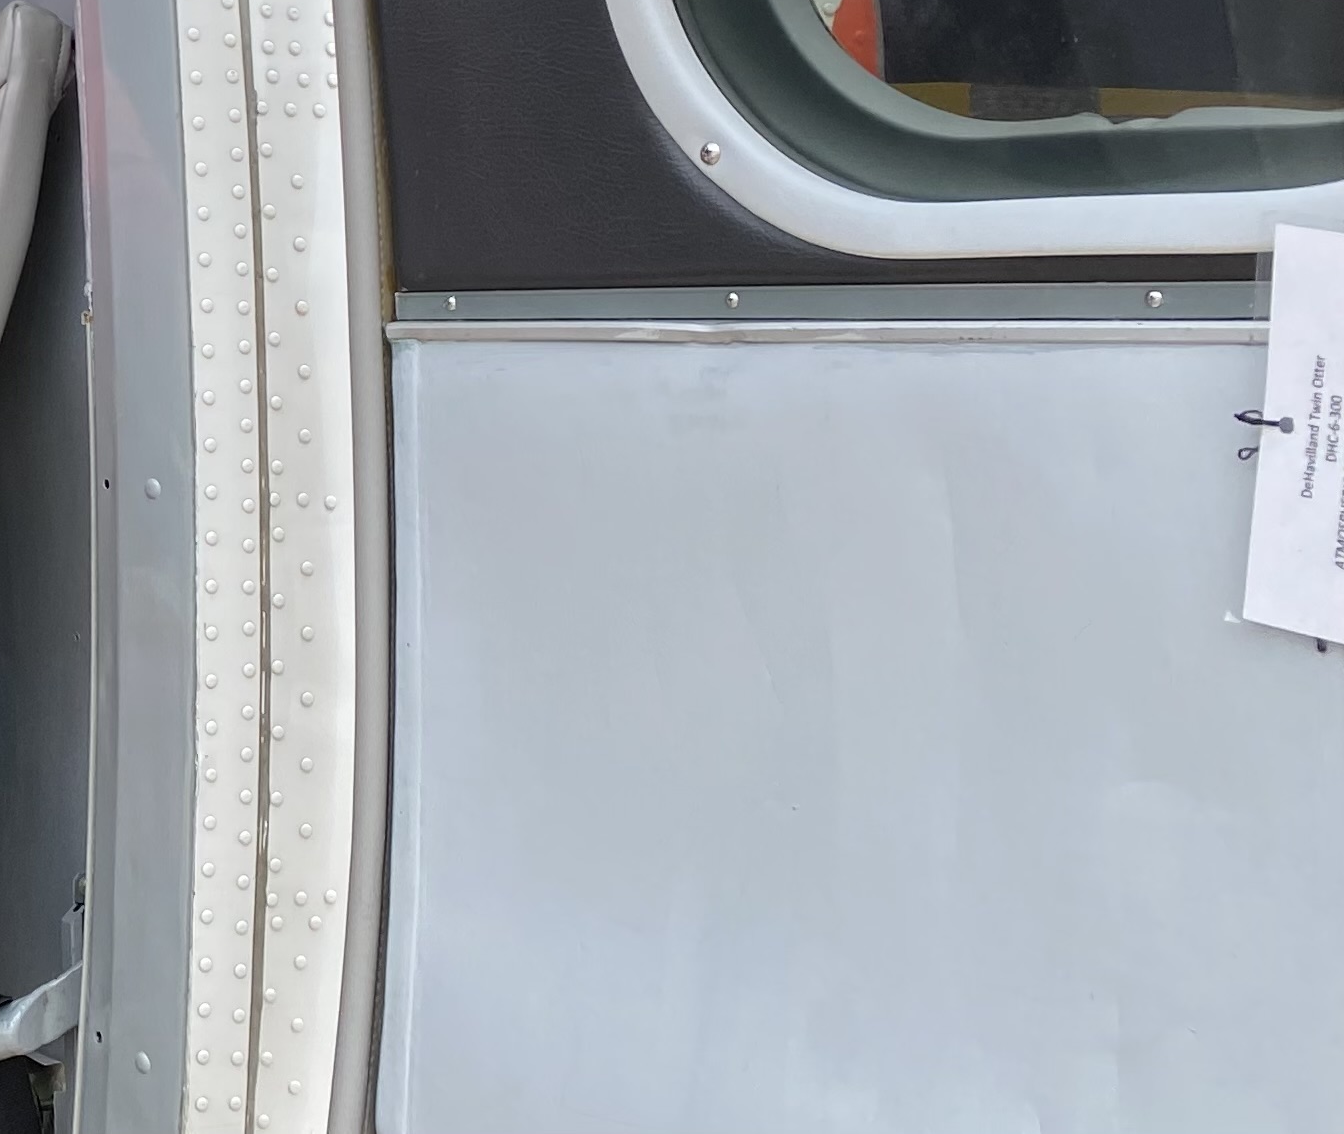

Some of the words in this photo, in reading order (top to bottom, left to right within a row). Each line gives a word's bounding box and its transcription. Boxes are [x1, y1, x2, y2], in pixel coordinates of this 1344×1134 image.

[1312, 354, 1327, 388] Otter
[1309, 392, 1323, 421] Twin
[1325, 395, 1343, 463] DHC-6-300
[1301, 424, 1320, 499] DeHavilland
